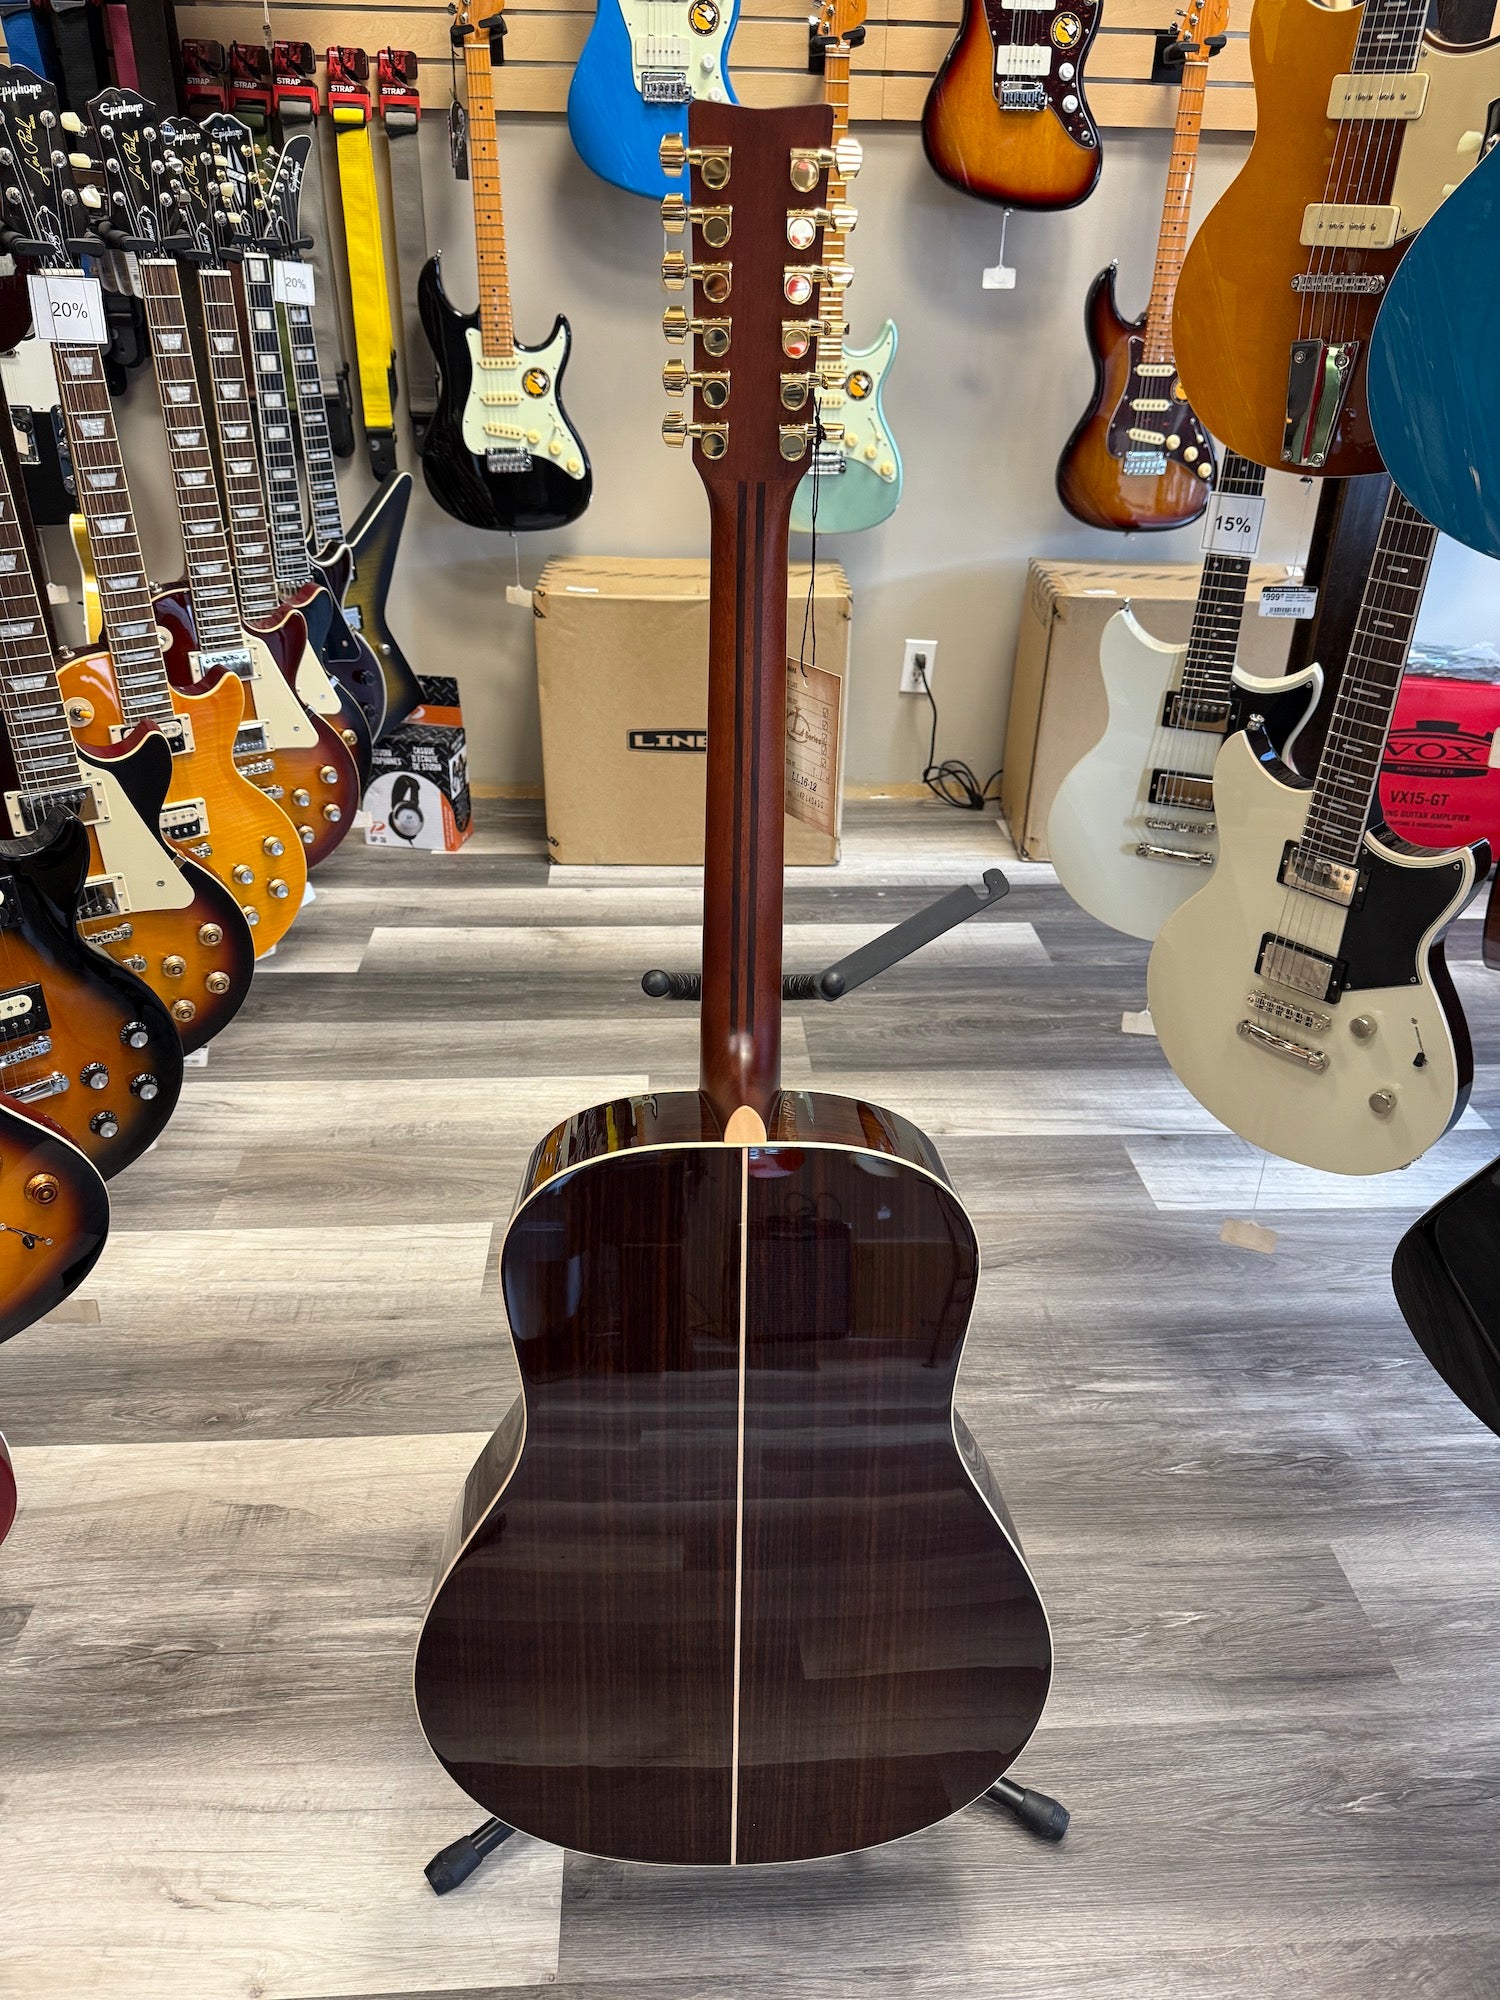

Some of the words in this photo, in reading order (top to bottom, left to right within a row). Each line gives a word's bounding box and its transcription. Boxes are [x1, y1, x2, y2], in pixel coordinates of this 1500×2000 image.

[186, 77, 210, 86] STRAP
[233, 81, 257, 89] STRAP
[276, 77, 301, 86] STRAP
[330, 85, 355, 93] STRAP
[381, 87, 406, 96] STRAP
[99, 102, 144, 121] Epiphone
[172, 129, 201, 146] piphone
[211, 126, 243, 142] Epiphone
[284, 276, 307, 290] 20%
[50, 301, 88, 319] 20%
[1215, 515, 1251, 533] 15%
[634, 735, 707, 748] LINE
[1386, 741, 1484, 762] VOX
[1390, 790, 1450, 807] VX15-GT
[1400, 810, 1428, 819] GUITAR
[1430, 812, 1471, 822] AMPLIFIER
